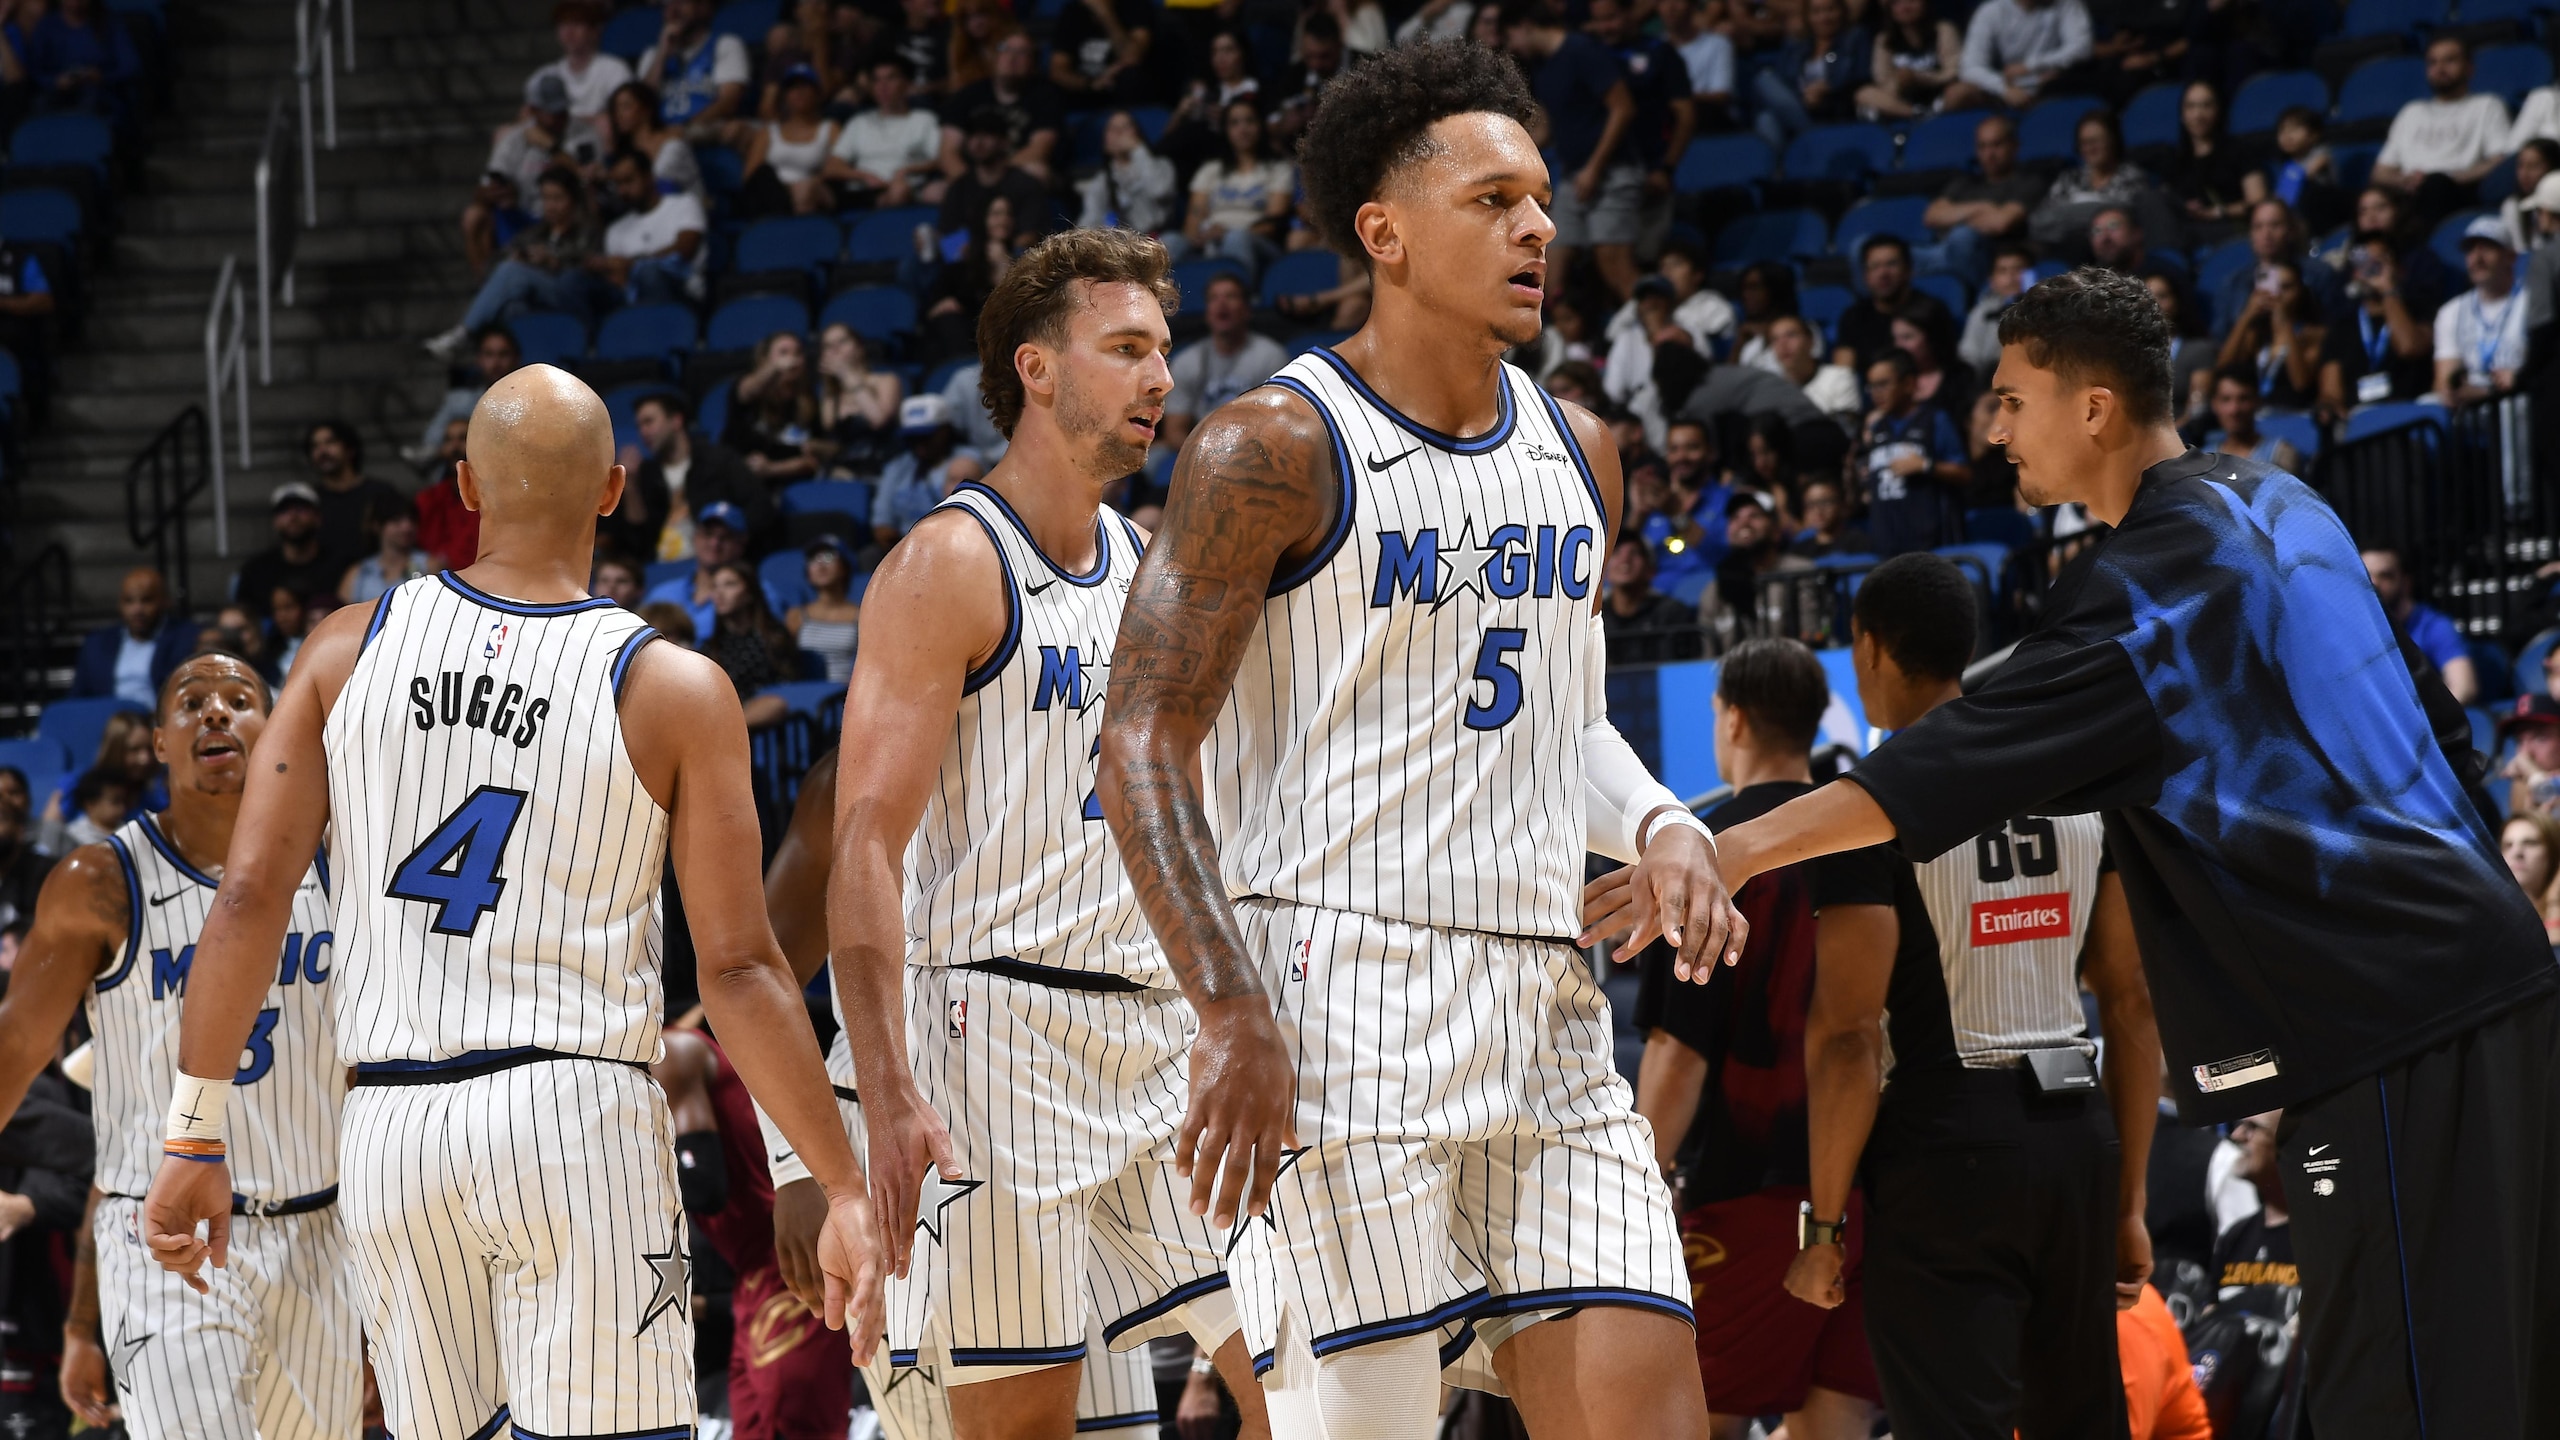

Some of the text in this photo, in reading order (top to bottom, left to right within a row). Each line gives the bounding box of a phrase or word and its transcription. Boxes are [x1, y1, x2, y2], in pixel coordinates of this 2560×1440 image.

[410, 671, 550, 749] SUGGS
[1463, 627, 1528, 732] 5
[384, 784, 529, 938] 4
[1979, 907, 2062, 935] Emirates
[150, 930, 334, 1001] MIC
